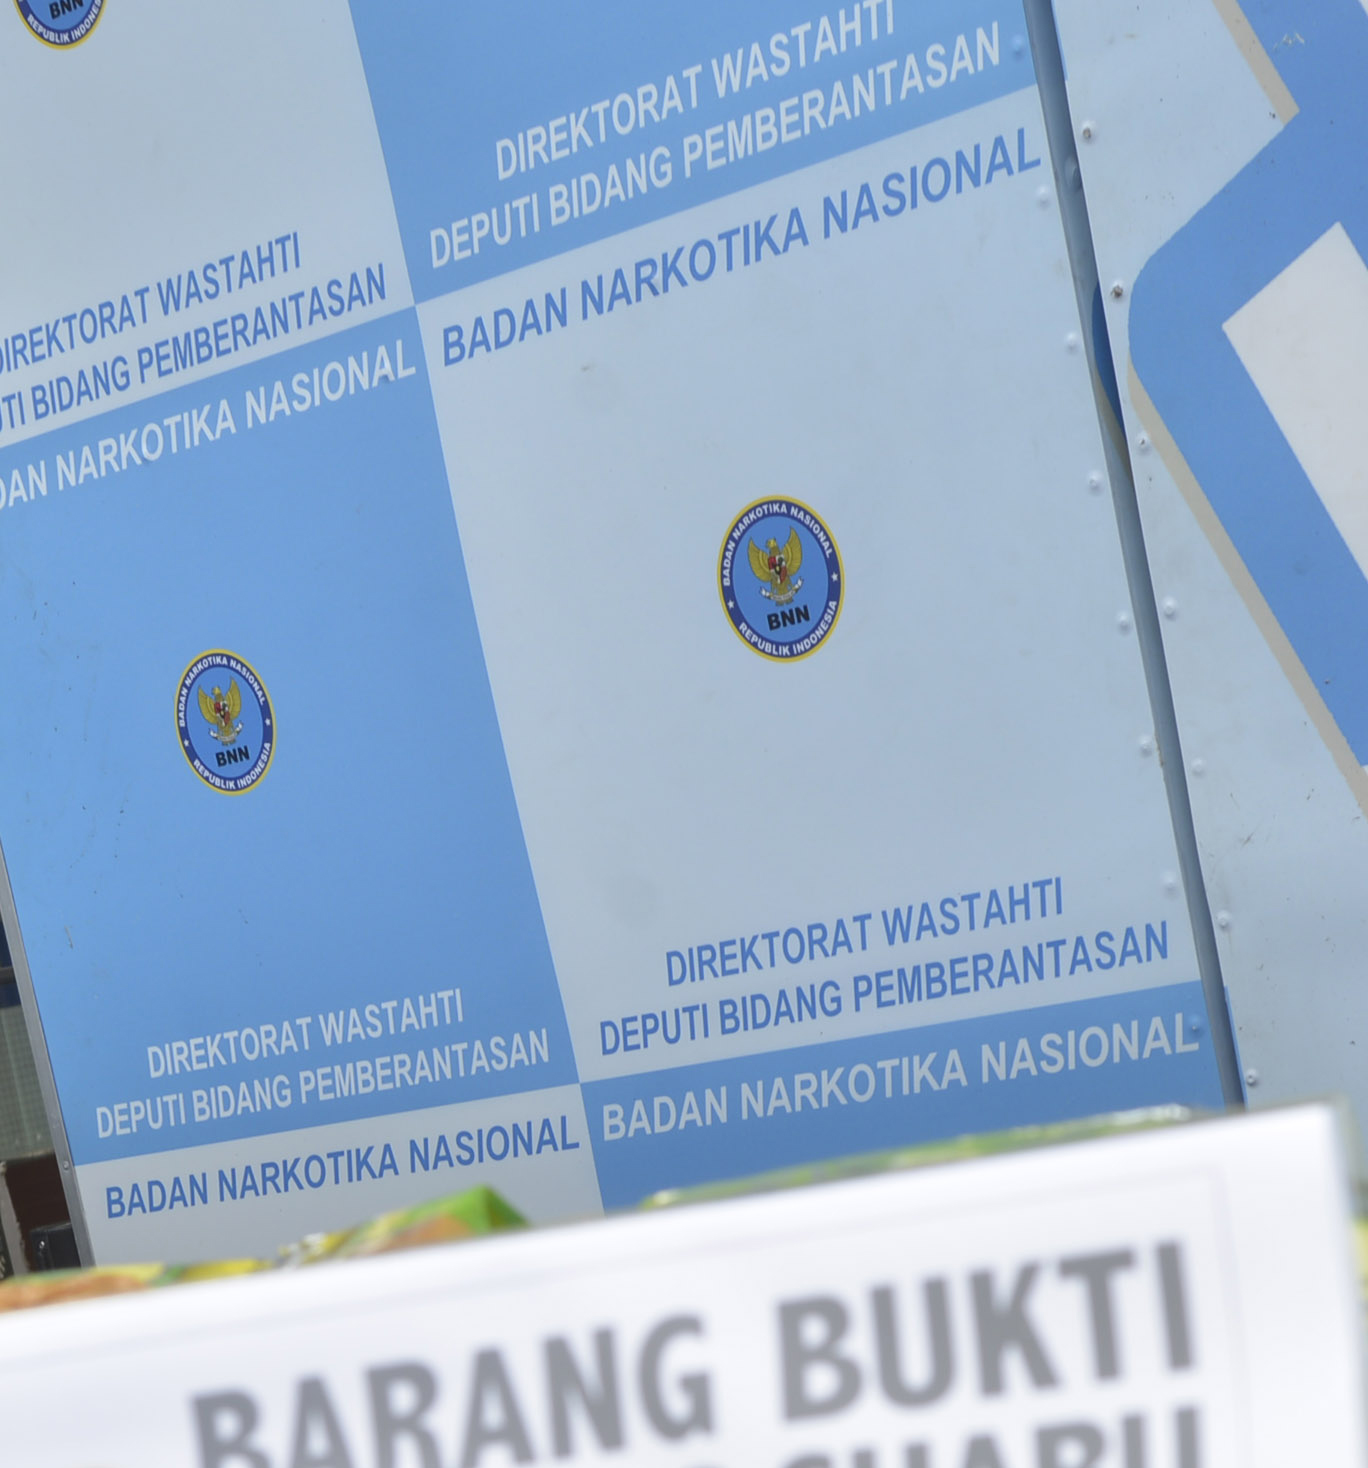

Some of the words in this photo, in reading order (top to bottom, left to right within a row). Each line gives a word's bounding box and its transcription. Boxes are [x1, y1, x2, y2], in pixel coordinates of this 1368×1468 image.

[27, 13, 70, 43] REPUBLIK
[495, 64, 704, 181] DIREKTORAT
[710, 0, 896, 99] WASTAHTI
[429, 193, 541, 270] DEPUTI
[550, 146, 674, 226] BIDANG
[682, 21, 1002, 179] PEMBERANTASAN
[156, 230, 302, 318] WASTAHTI
[442, 286, 570, 368] BADAN
[580, 206, 810, 322] NARKOTIKA
[822, 127, 1043, 240] NASIONAL
[30, 352, 132, 421] BIDANG
[136, 262, 388, 384] PEMBERANTASAN
[56, 396, 237, 493] NARKOTIKA
[244, 337, 418, 430] NASIONAL
[723, 541, 736, 586] BADAN
[732, 502, 787, 540] NARKOTIKA
[790, 506, 833, 558] NASIONAL
[739, 621, 791, 657] REPUBLIK
[792, 600, 837, 655] INDONESIA
[767, 604, 810, 631] BNN
[179, 688, 188, 727] BADAN
[185, 655, 228, 687] NARKOTIKA
[230, 658, 265, 706] NASIONAL
[193, 758, 236, 790] REPUBLIK
[237, 742, 271, 789] INDONESIA
[215, 745, 250, 768] BNN
[665, 914, 872, 987] DIREKTORAT
[881, 876, 1064, 946] WASTAHTI
[147, 1016, 313, 1079] DIREKTORAT
[318, 988, 465, 1047] WASTAHTI
[599, 1002, 709, 1056] DEPUTI
[718, 979, 843, 1036] BIDANG
[852, 920, 1170, 1013] PEMBERANTASAN
[95, 1092, 187, 1139] DEPUTI
[193, 1074, 293, 1123] BIDANG
[298, 1027, 550, 1105] PEMBERANTASAN
[601, 1085, 729, 1142] BADAN
[739, 1047, 969, 1121] NARKOTIKA
[978, 1012, 1200, 1085] NASIONAL
[105, 1172, 210, 1219] BADAN
[217, 1143, 401, 1203] NARKOTIKA
[408, 1115, 581, 1174] NASIONAL
[774, 1237, 1200, 1426] BUKTI
